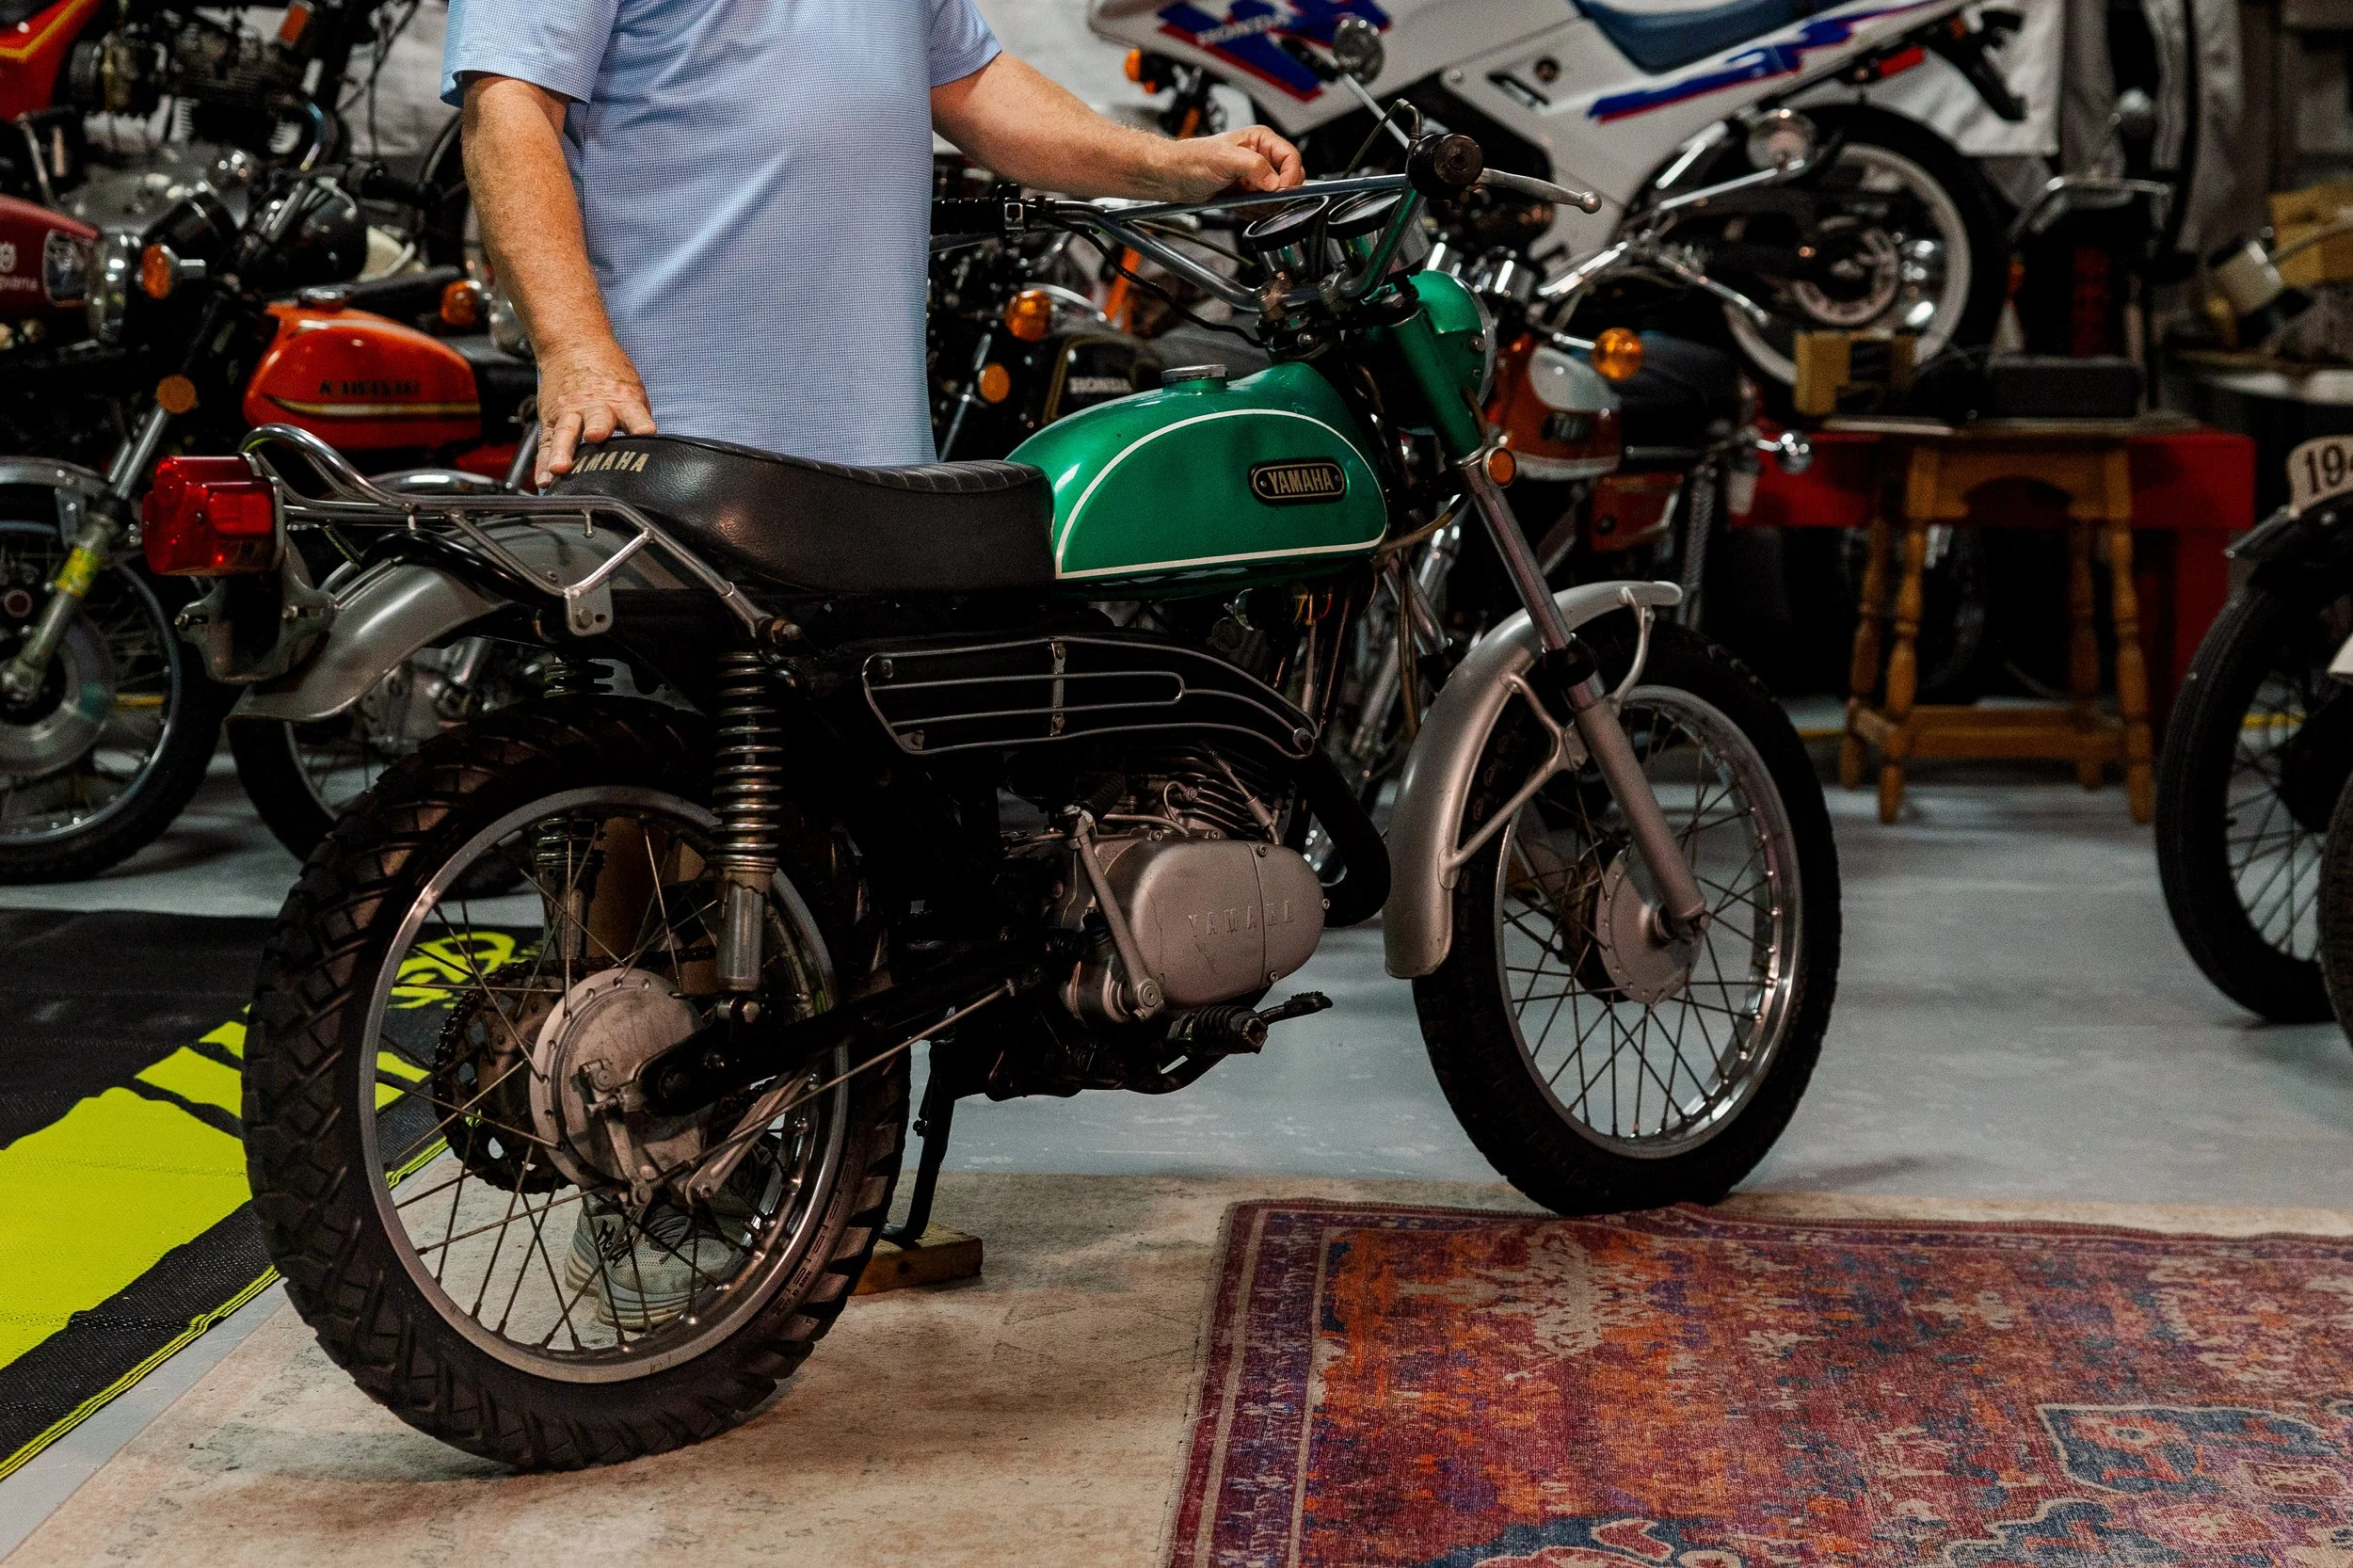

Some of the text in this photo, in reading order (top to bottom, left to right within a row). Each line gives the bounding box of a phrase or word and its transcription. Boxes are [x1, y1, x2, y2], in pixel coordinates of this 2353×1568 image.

[571, 452, 649, 474] AMAHA
[2306, 443, 2353, 495] 19
[1267, 468, 1335, 494] YAMAHA
